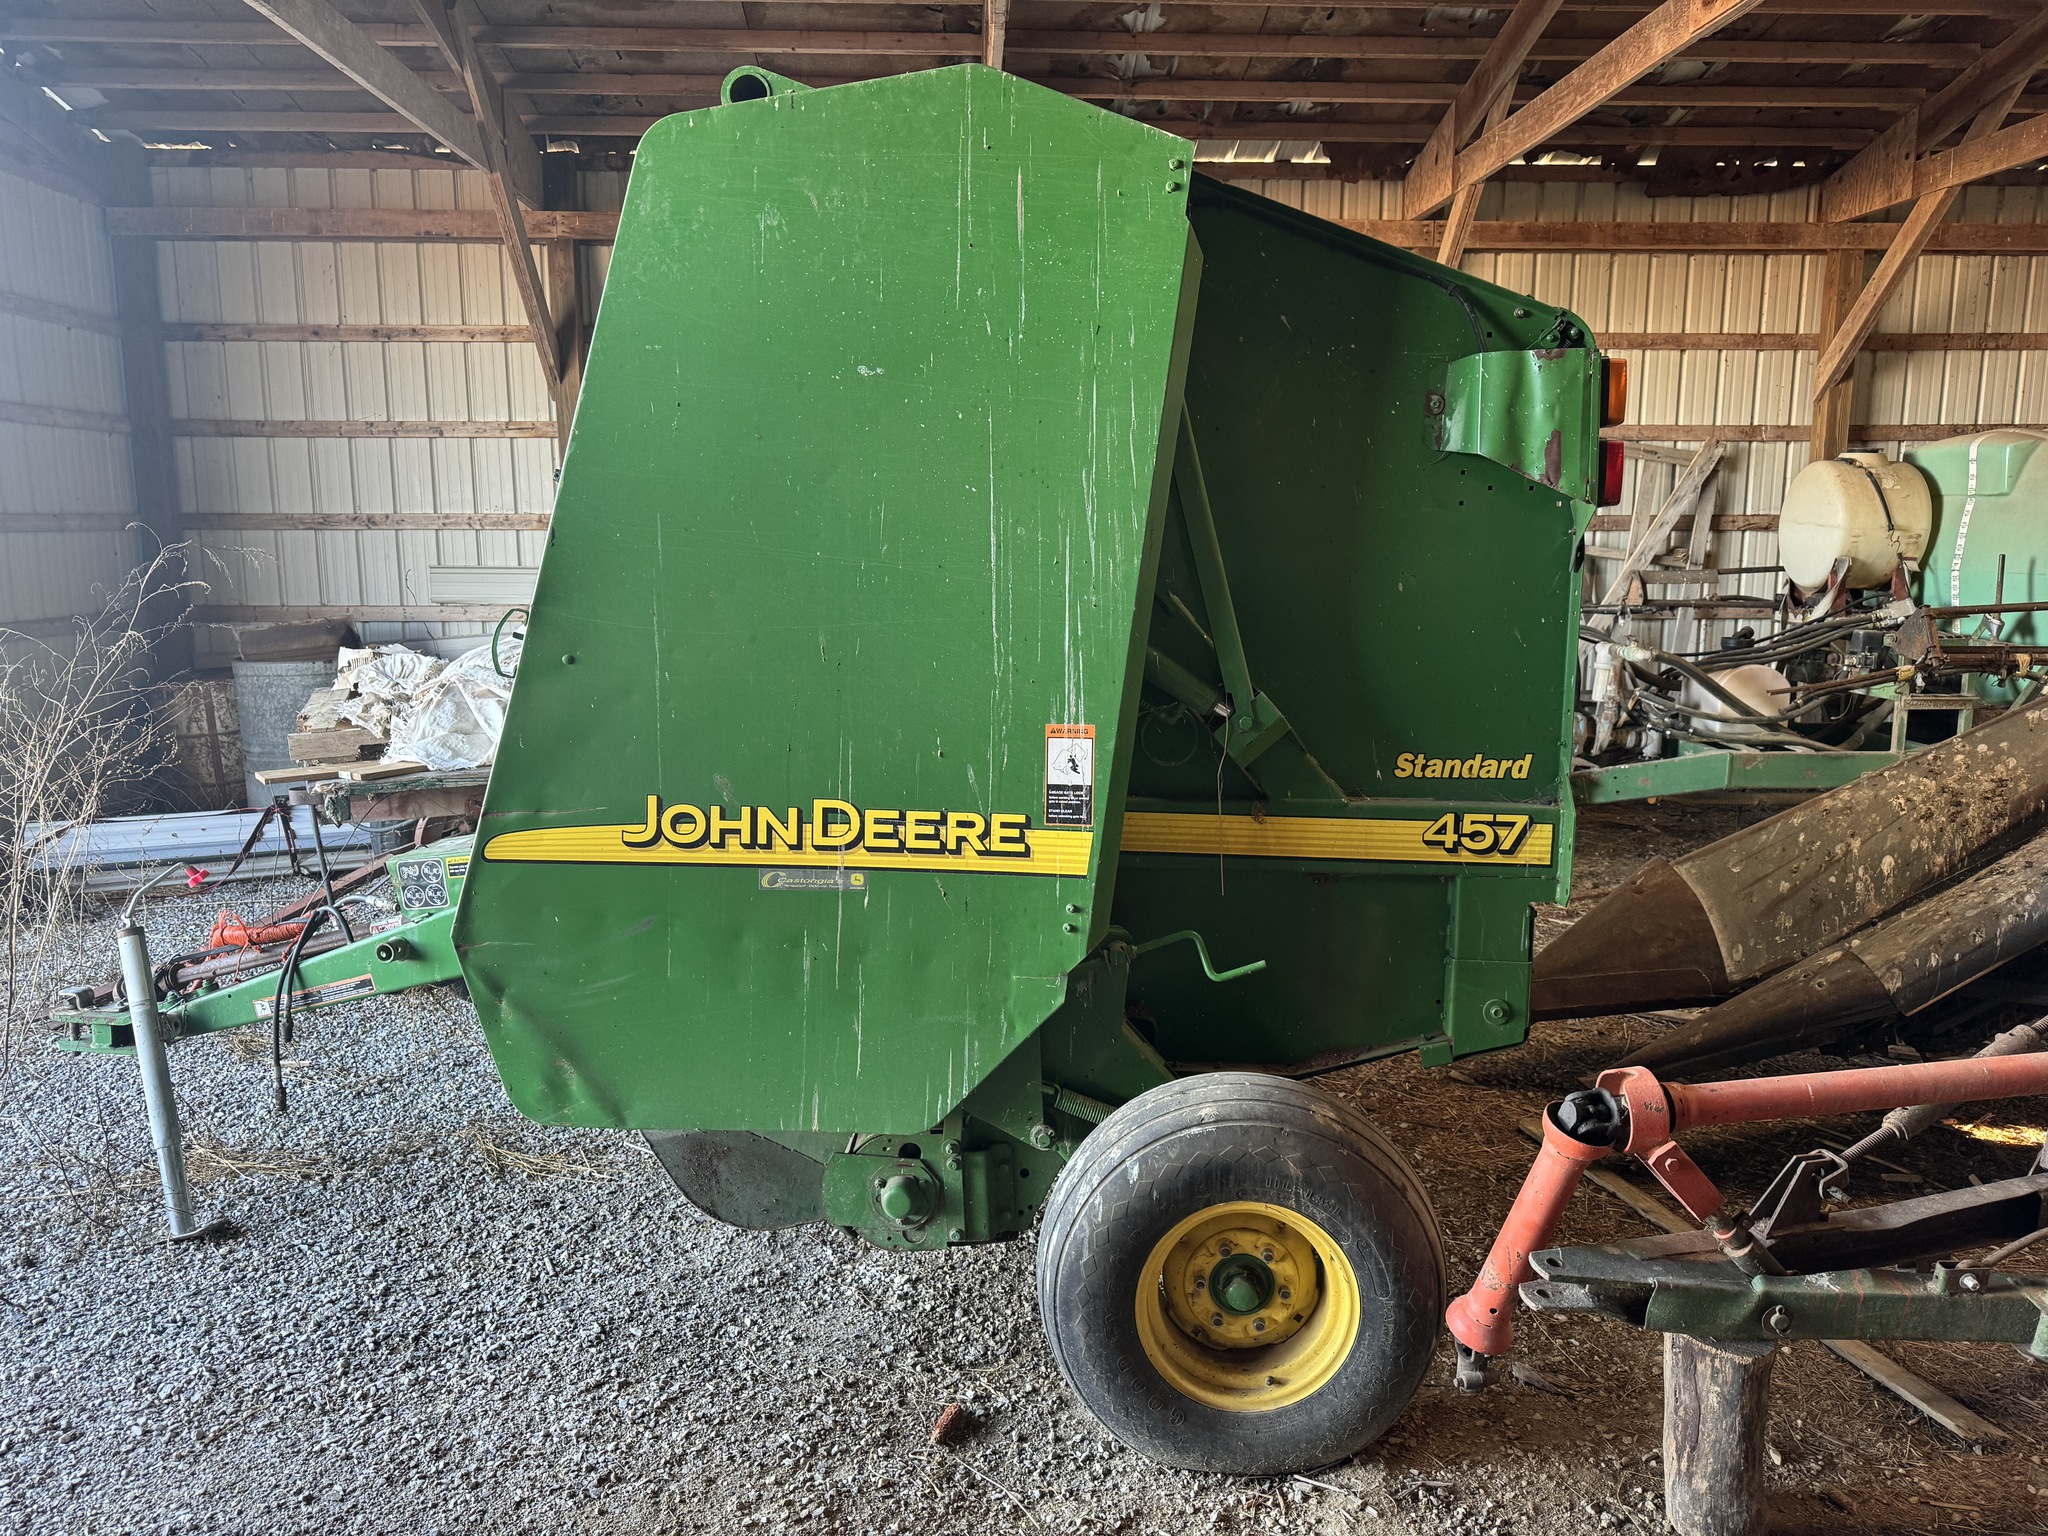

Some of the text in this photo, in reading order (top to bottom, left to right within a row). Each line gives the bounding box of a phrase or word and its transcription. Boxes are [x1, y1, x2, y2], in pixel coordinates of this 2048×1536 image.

[1394, 752, 1533, 780] Standard
[621, 794, 1030, 856] JOHN DEERE
[1422, 812, 1533, 855] 457
